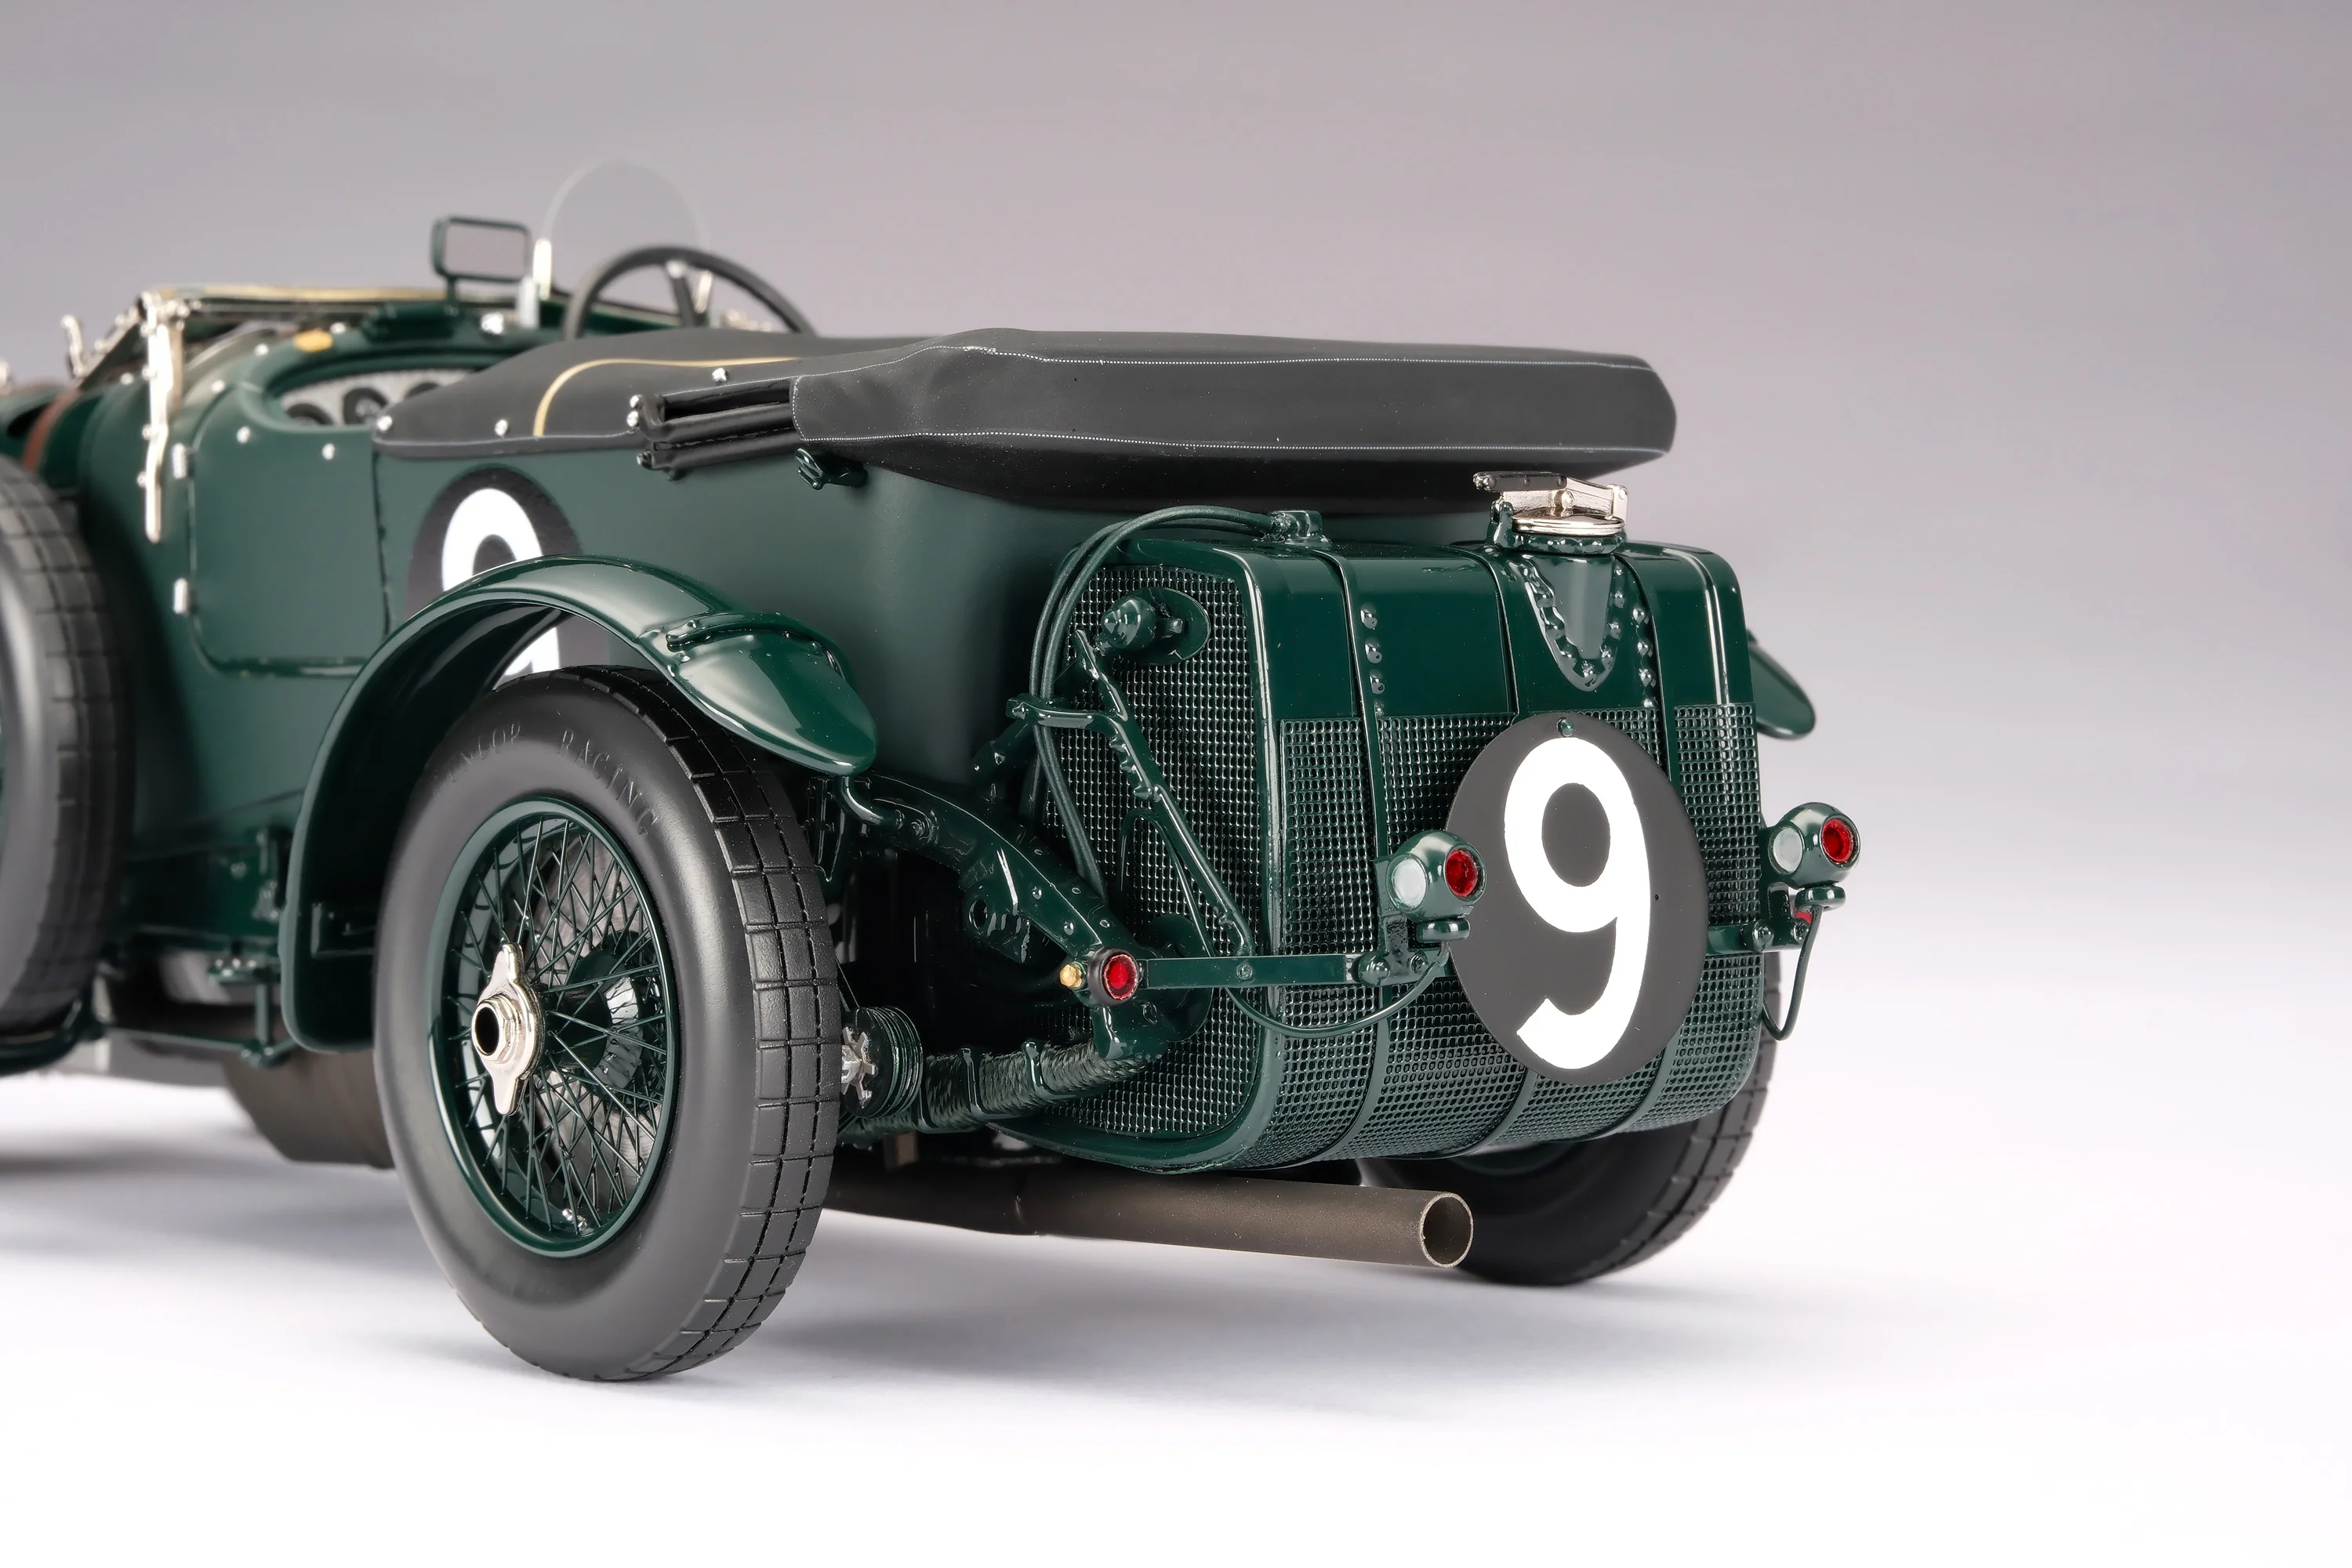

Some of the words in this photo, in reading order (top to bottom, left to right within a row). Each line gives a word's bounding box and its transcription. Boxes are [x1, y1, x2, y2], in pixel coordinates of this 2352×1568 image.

[431, 722, 521, 798] NLOP
[557, 728, 659, 836] RACING
[1504, 737, 1651, 1069] 9
